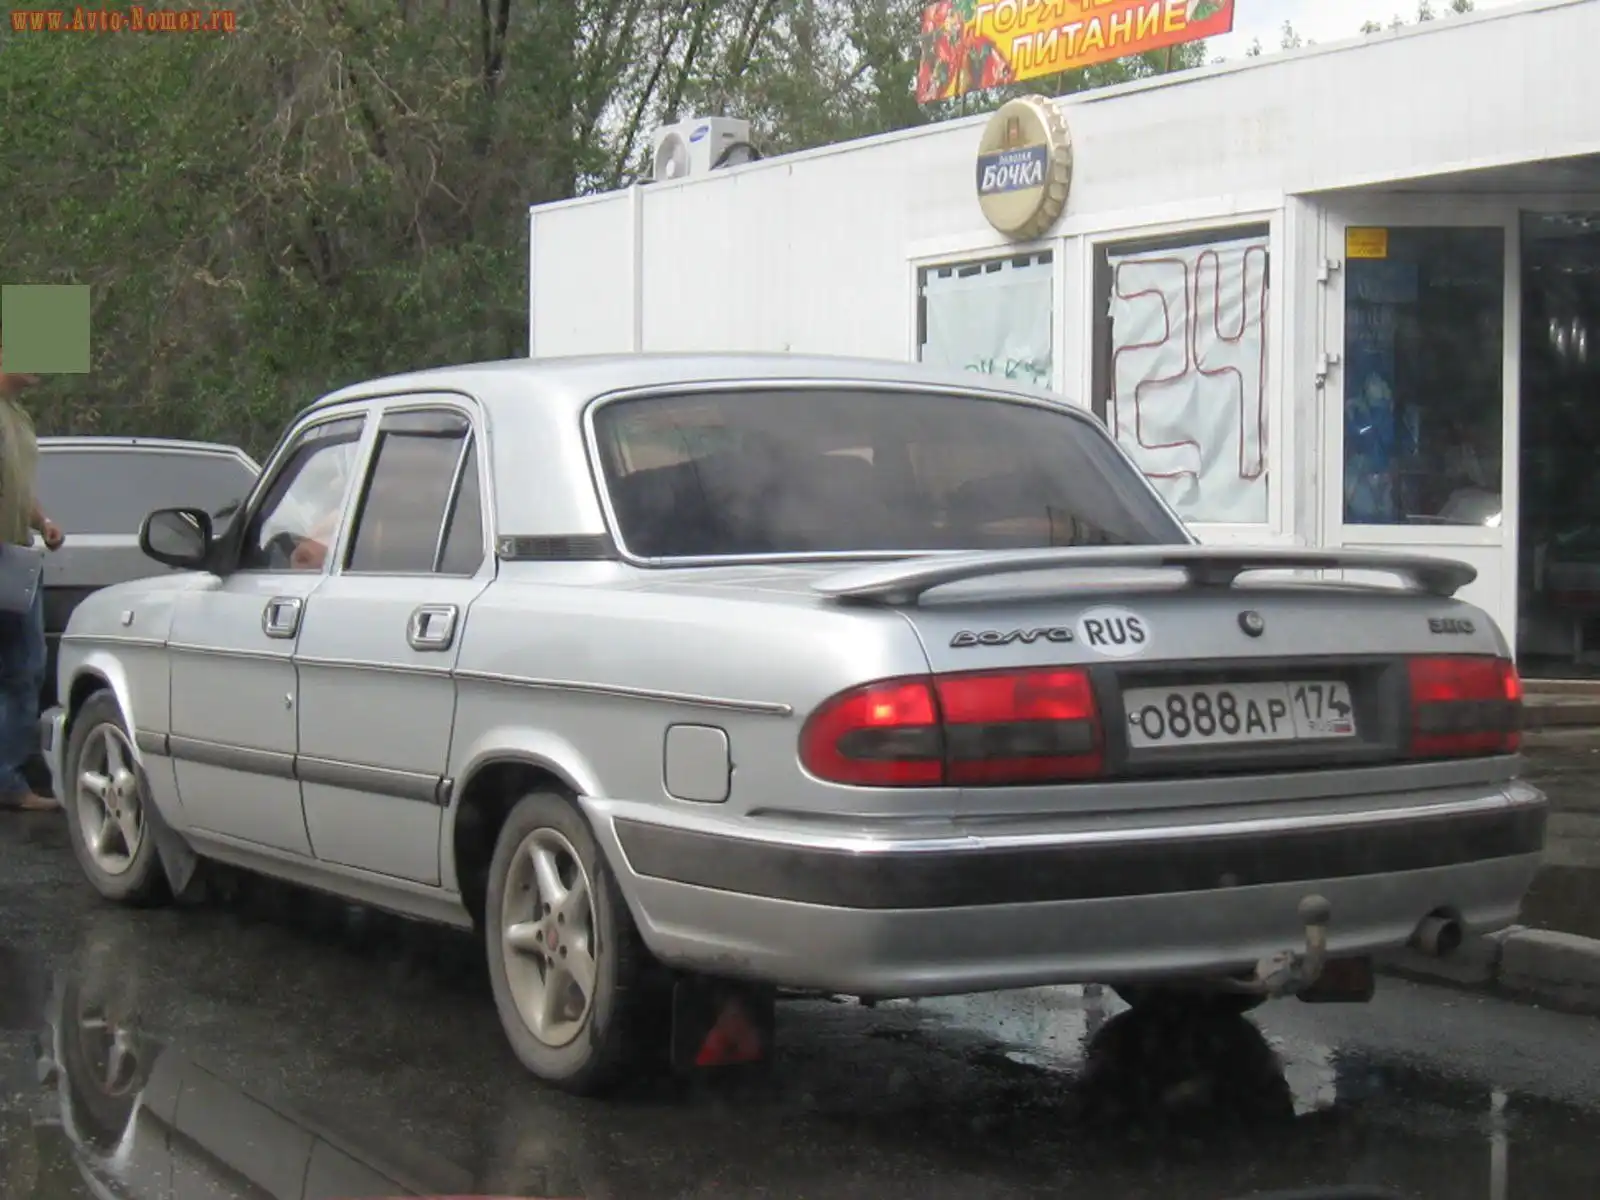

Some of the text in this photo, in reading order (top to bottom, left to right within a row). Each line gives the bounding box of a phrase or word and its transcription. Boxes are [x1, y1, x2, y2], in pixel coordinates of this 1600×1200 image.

[1009, 1, 1187, 69] ПИТАНИЕ
[981, 160, 1043, 191] БОЧКА
[1112, 244, 1267, 480] 24
[1084, 616, 1146, 646] RUS
[1294, 685, 1351, 719] 174
